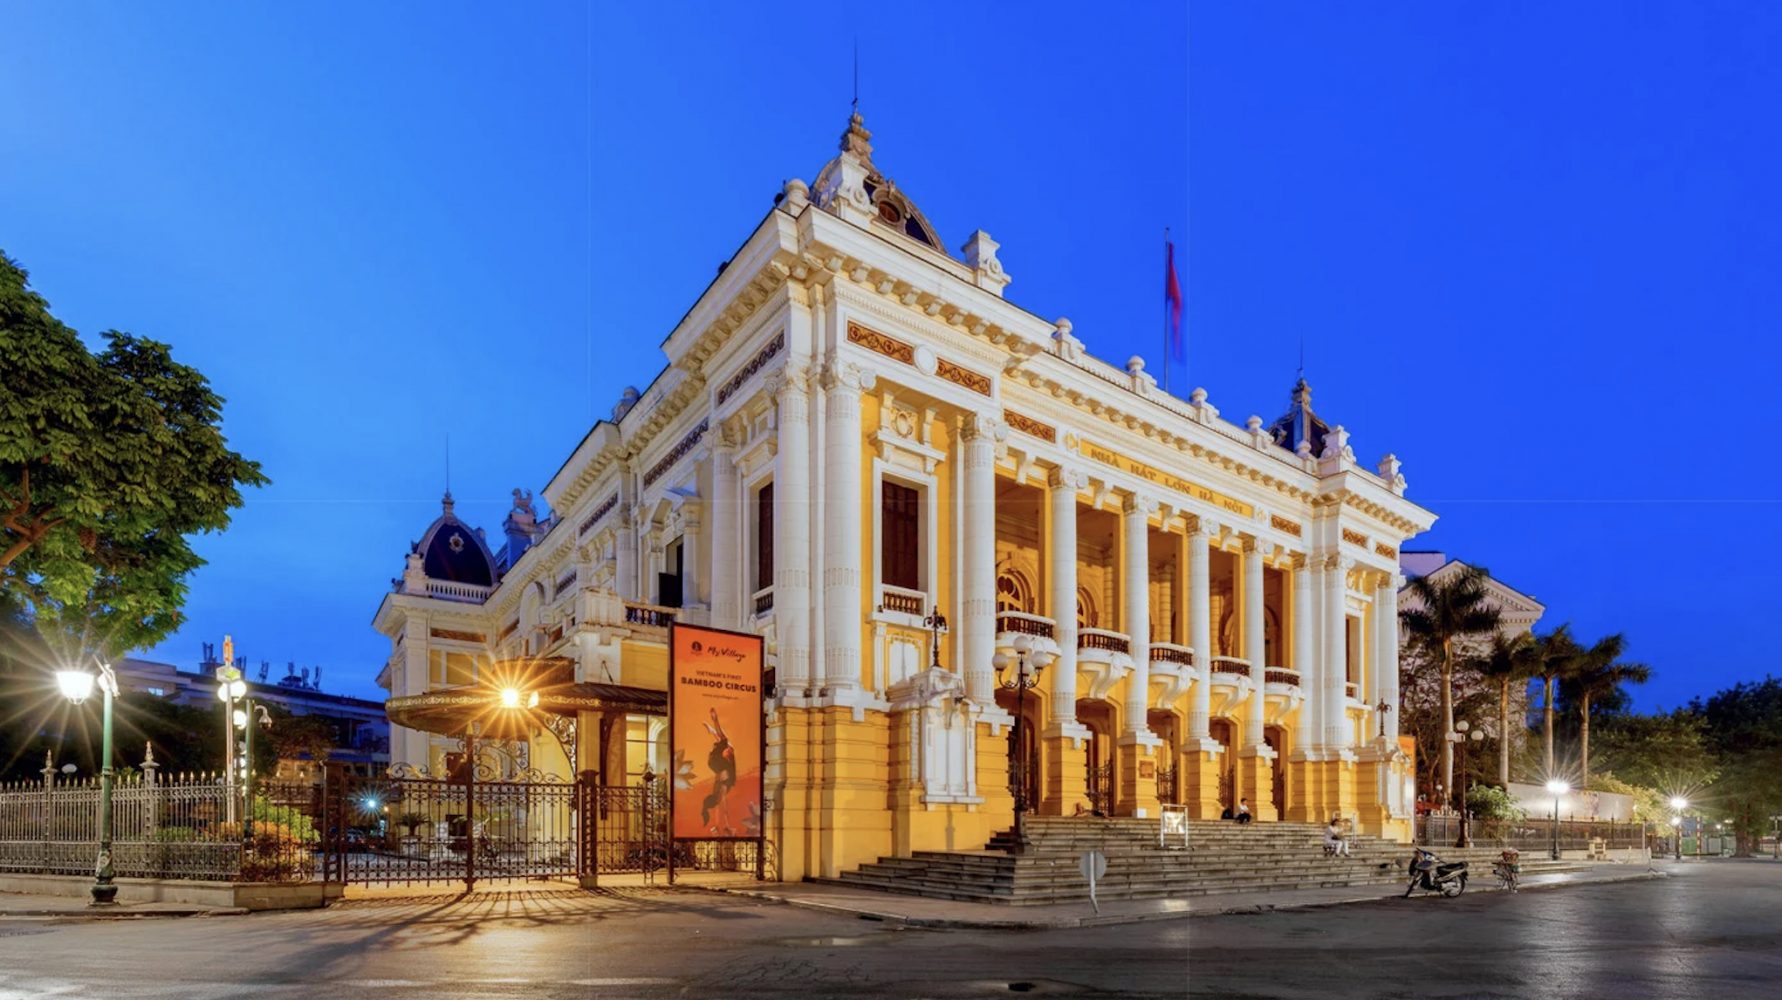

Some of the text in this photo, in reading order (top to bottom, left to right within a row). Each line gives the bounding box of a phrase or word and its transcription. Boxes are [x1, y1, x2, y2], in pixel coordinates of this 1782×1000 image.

[707, 647, 720, 656] My
[721, 648, 746, 663] Village
[696, 671, 726, 679] VIETNAM'S
[681, 677, 757, 693] BAMBOO CIRCUS
